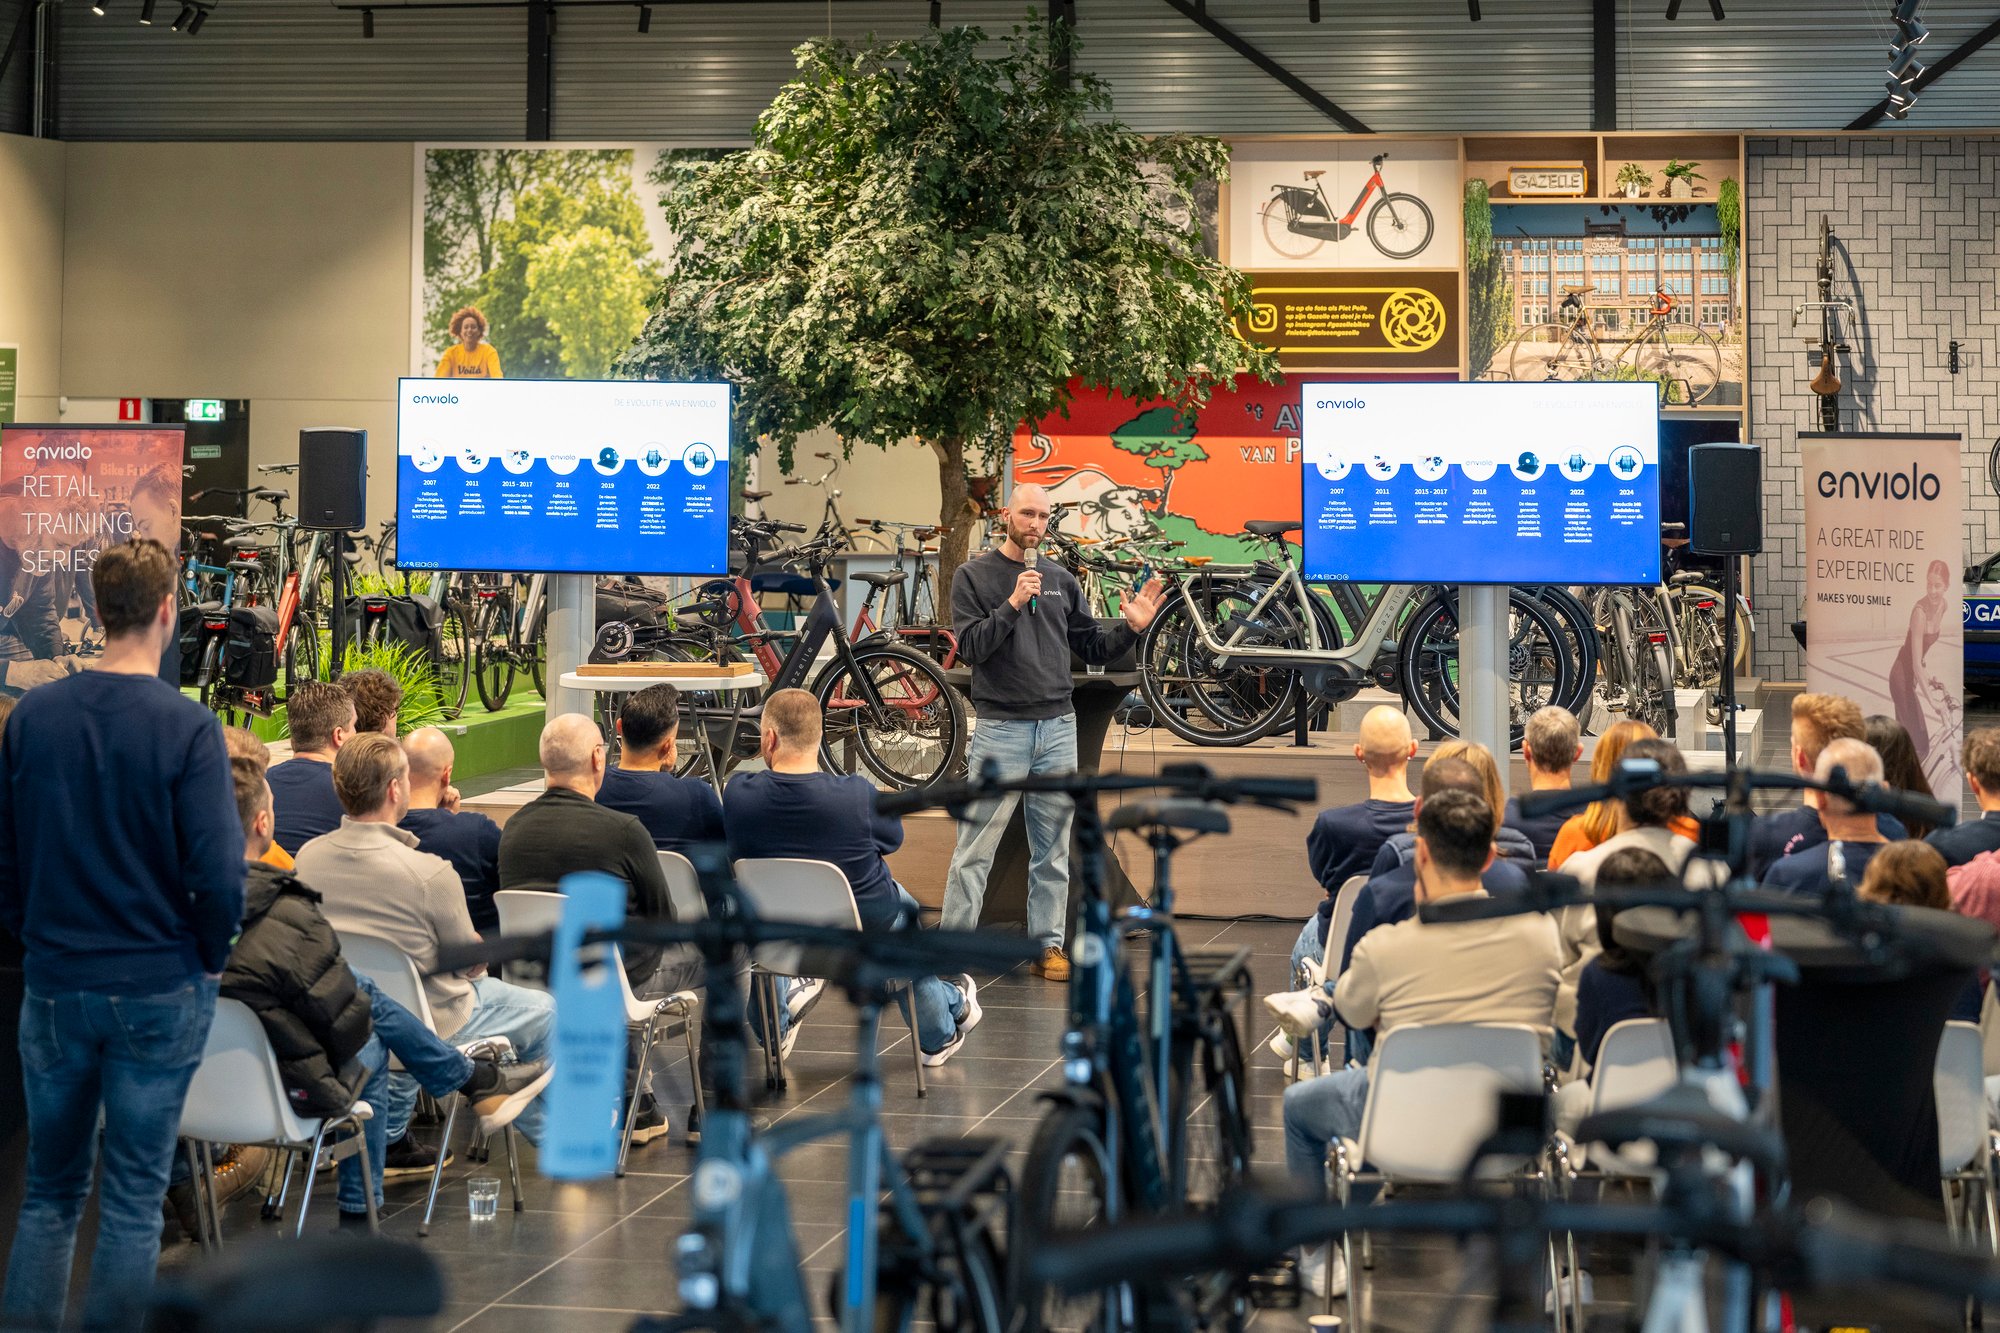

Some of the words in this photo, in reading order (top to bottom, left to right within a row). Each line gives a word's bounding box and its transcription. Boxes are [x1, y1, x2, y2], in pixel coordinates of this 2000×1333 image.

[1514, 173, 1580, 189] GAZELLE
[1285, 304, 1295, 312] Ga
[1296, 304, 1304, 312] op
[1305, 304, 1313, 312] de
[1314, 304, 1327, 312] foto
[1328, 304, 1338, 312] als
[1338, 304, 1351, 312] Piet
[1352, 304, 1368, 312] Pelle
[1285, 313, 1294, 321] op
[1295, 313, 1306, 321] zijn
[1307, 313, 1330, 321] Gazelle
[1331, 313, 1340, 321] en
[1340, 313, 1354, 321] deel
[1354, 313, 1361, 321] je
[1362, 313, 1375, 321] foto
[1285, 321, 1294, 329] op
[1295, 321, 1326, 329] instagram
[1327, 321, 1370, 329] #gazellebikes
[412, 393, 459, 405] enviolo
[1316, 397, 1366, 410] enviolo
[23, 442, 93, 460] enviolo
[1240, 445, 1277, 464] VAN
[23, 475, 100, 498] RETAIL
[1817, 461, 1941, 501] enviolo
[21, 512, 134, 535] TRAINING
[1817, 527, 1828, 547] A
[1831, 527, 1885, 550] GREAT
[1889, 529, 1925, 551] RIDE
[1817, 559, 1915, 584] EXPERIENCE
[1817, 592, 1845, 604] MAKES
[1846, 593, 1866, 606] YOU
[1866, 594, 1892, 607] SMILE
[1376, 588, 1405, 634] Gazelle
